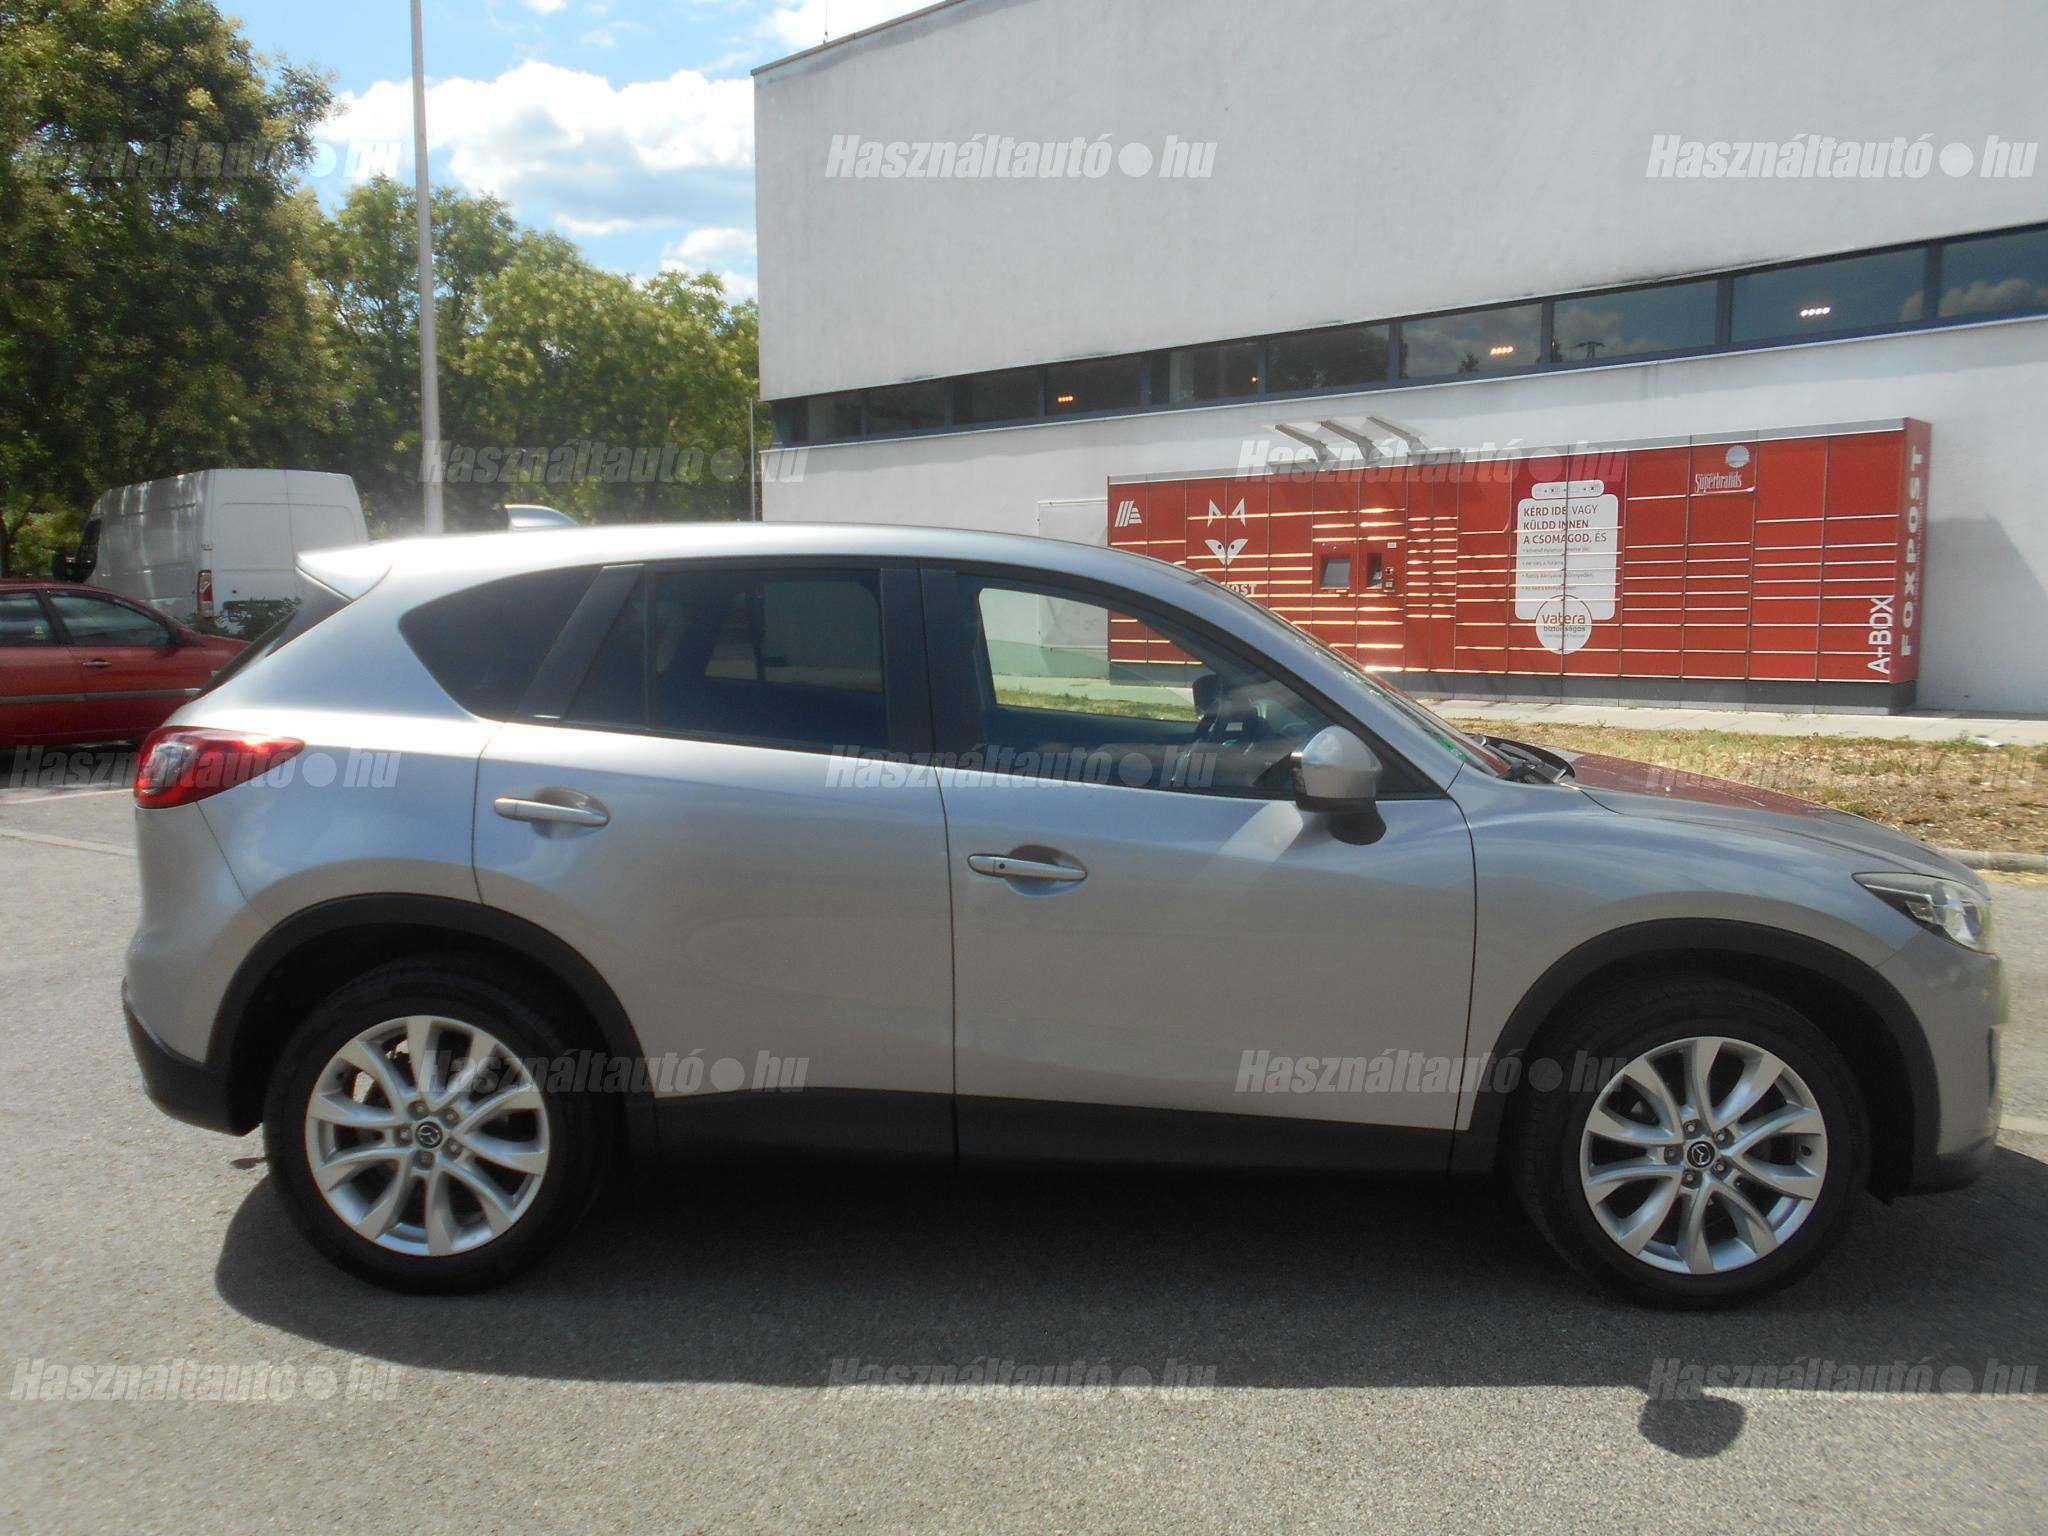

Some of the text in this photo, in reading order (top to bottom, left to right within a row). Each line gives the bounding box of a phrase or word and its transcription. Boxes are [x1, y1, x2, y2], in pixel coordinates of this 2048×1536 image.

[1523, 504, 1598, 517] KÉRD IDE VAGY
[1523, 519, 1589, 530] KÜLDD INNEN
[1523, 531, 1607, 544] A CSOMAGOD, ÉS
[1901, 446, 1923, 656] FOXPOST
[1541, 612, 1586, 625] vatera
